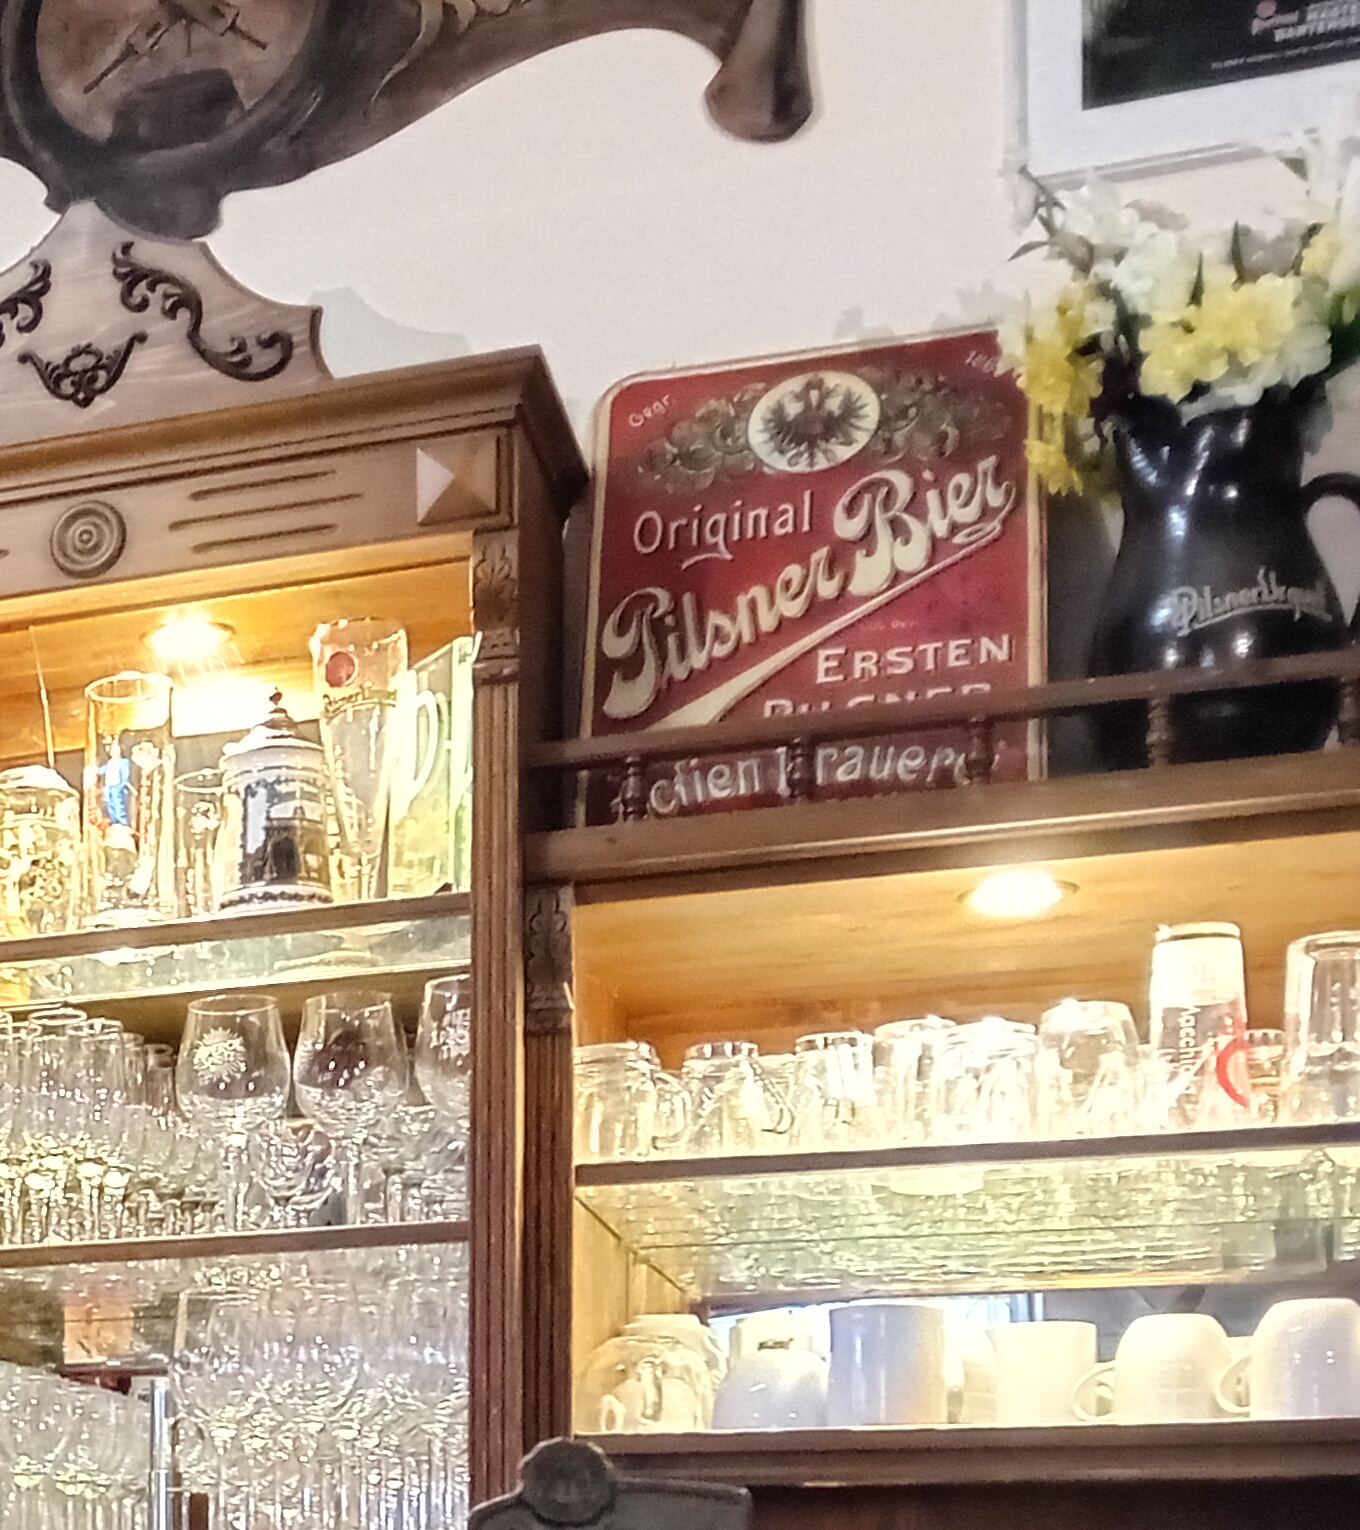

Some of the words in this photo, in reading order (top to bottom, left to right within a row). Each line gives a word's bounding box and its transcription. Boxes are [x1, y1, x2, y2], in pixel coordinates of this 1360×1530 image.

[633, 489, 814, 569] Original
[601, 546, 849, 720] Pilsner
[832, 454, 1018, 596] Bier
[816, 633, 1013, 684] ERSTEN
[612, 756, 762, 818] ctien
